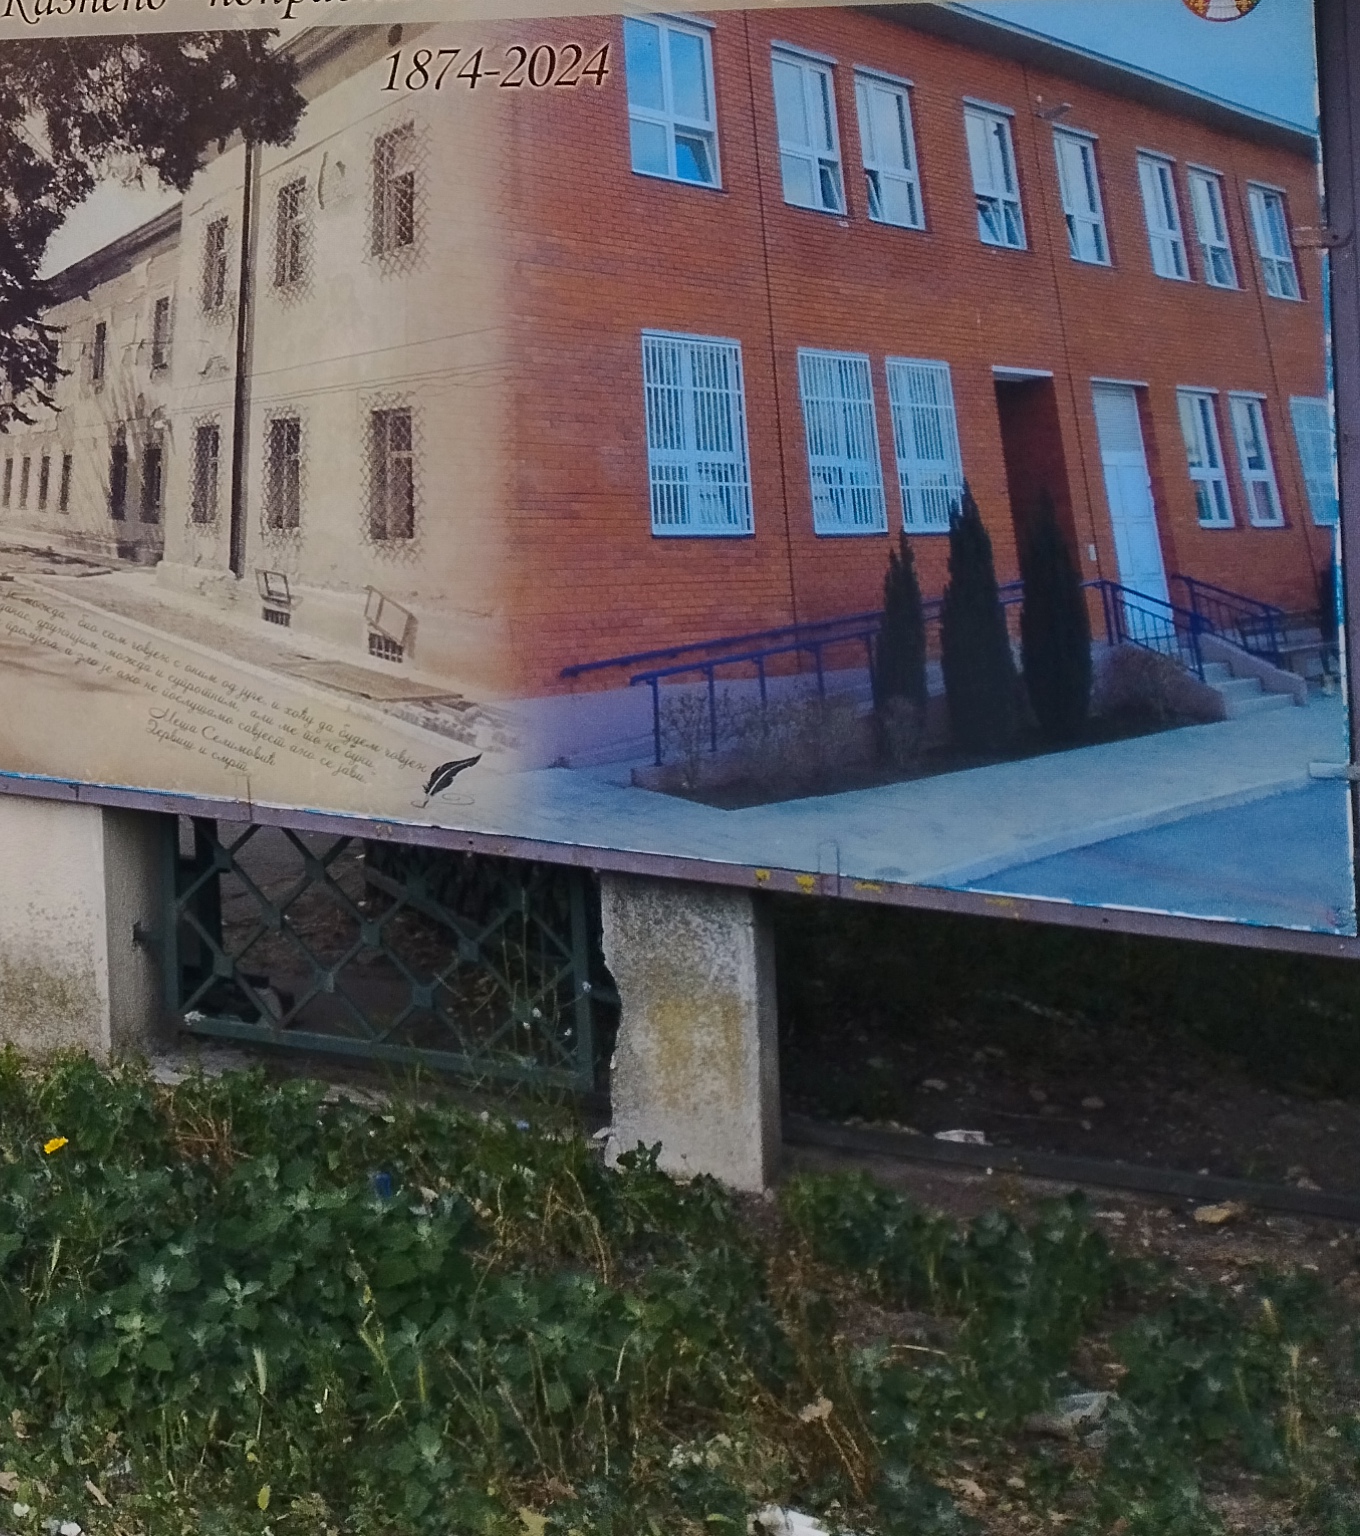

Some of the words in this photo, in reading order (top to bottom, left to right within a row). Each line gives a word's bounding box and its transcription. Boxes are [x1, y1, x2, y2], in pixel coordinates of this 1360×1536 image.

[381, 42, 610, 92] 1874-2024
[64, 647, 74, 656] а
[97, 662, 113, 675] је
[144, 682, 158, 693] не
[320, 757, 333, 769] се
[102, 629, 128, 646] сам
[173, 659, 182, 669] с
[184, 664, 217, 684] оним
[221, 680, 237, 697] од
[270, 701, 280, 711] и
[283, 706, 315, 727] хоћу
[317, 721, 335, 735] да
[338, 723, 382, 752] будем
[105, 650, 152, 673] можда
[155, 669, 165, 679] и
[250, 710, 275, 726] али
[324, 742, 341, 754] не
[149, 707, 199, 734] Меша
[201, 725, 276, 766] Селимовић
[198, 747, 208, 756] и
